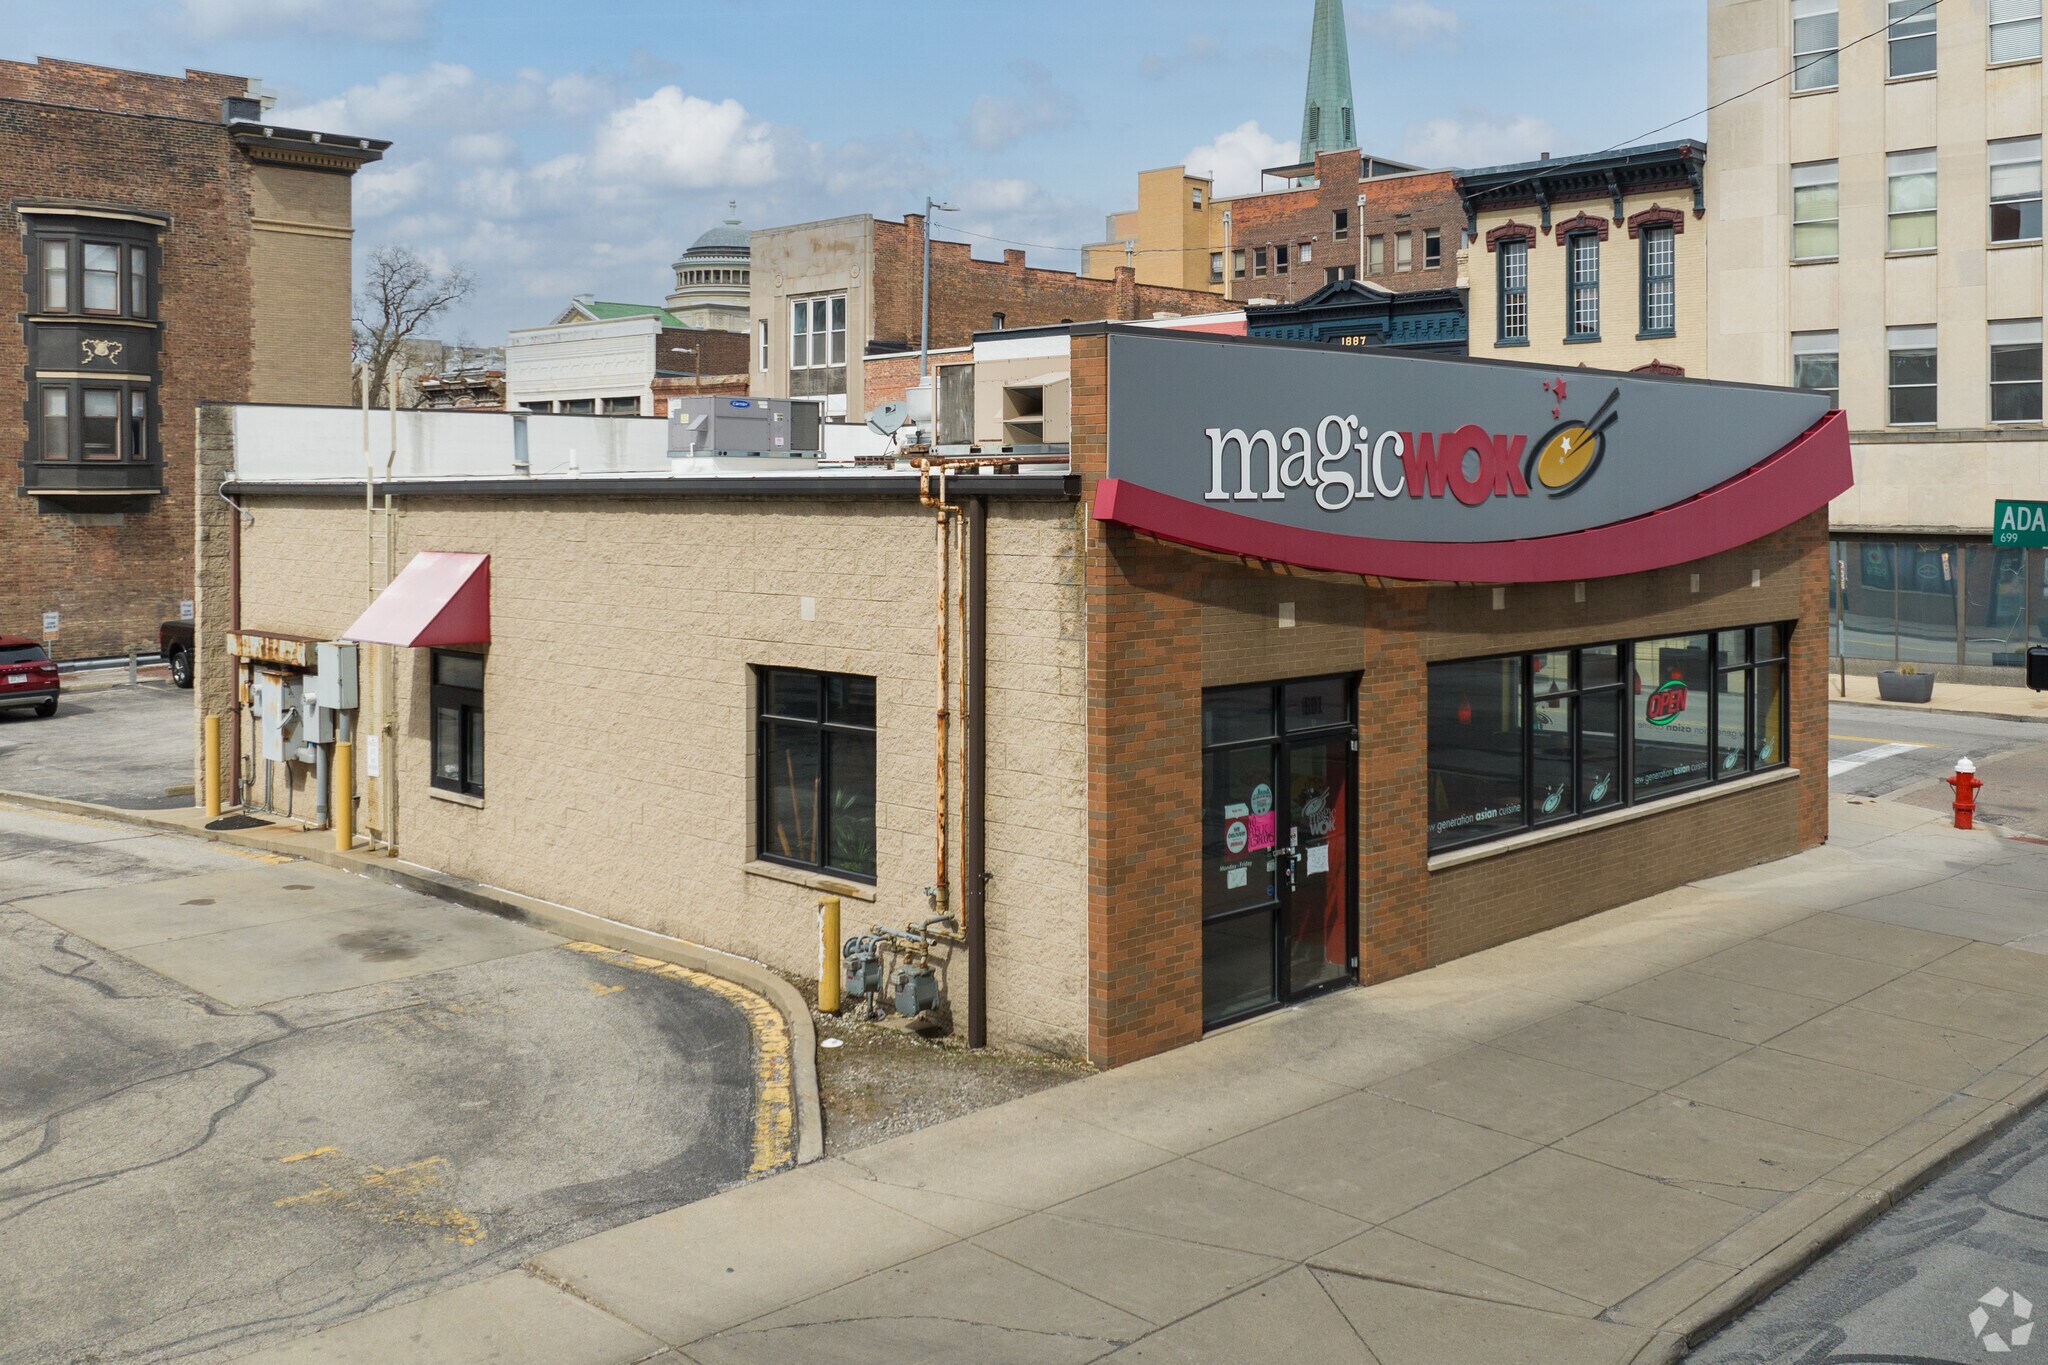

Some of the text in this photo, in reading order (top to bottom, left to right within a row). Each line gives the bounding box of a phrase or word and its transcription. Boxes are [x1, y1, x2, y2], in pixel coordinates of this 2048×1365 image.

[1341, 336, 1367, 346] 1887
[2001, 506, 2048, 532] ADA
[2000, 532, 2018, 543] 699
[1647, 687, 1689, 719] OPEN
[1644, 768, 1673, 785] generation
[1673, 763, 1691, 775] asian
[1436, 813, 1474, 833] generation
[1475, 807, 1498, 821] asian
[1498, 803, 1521, 816] cuisine
